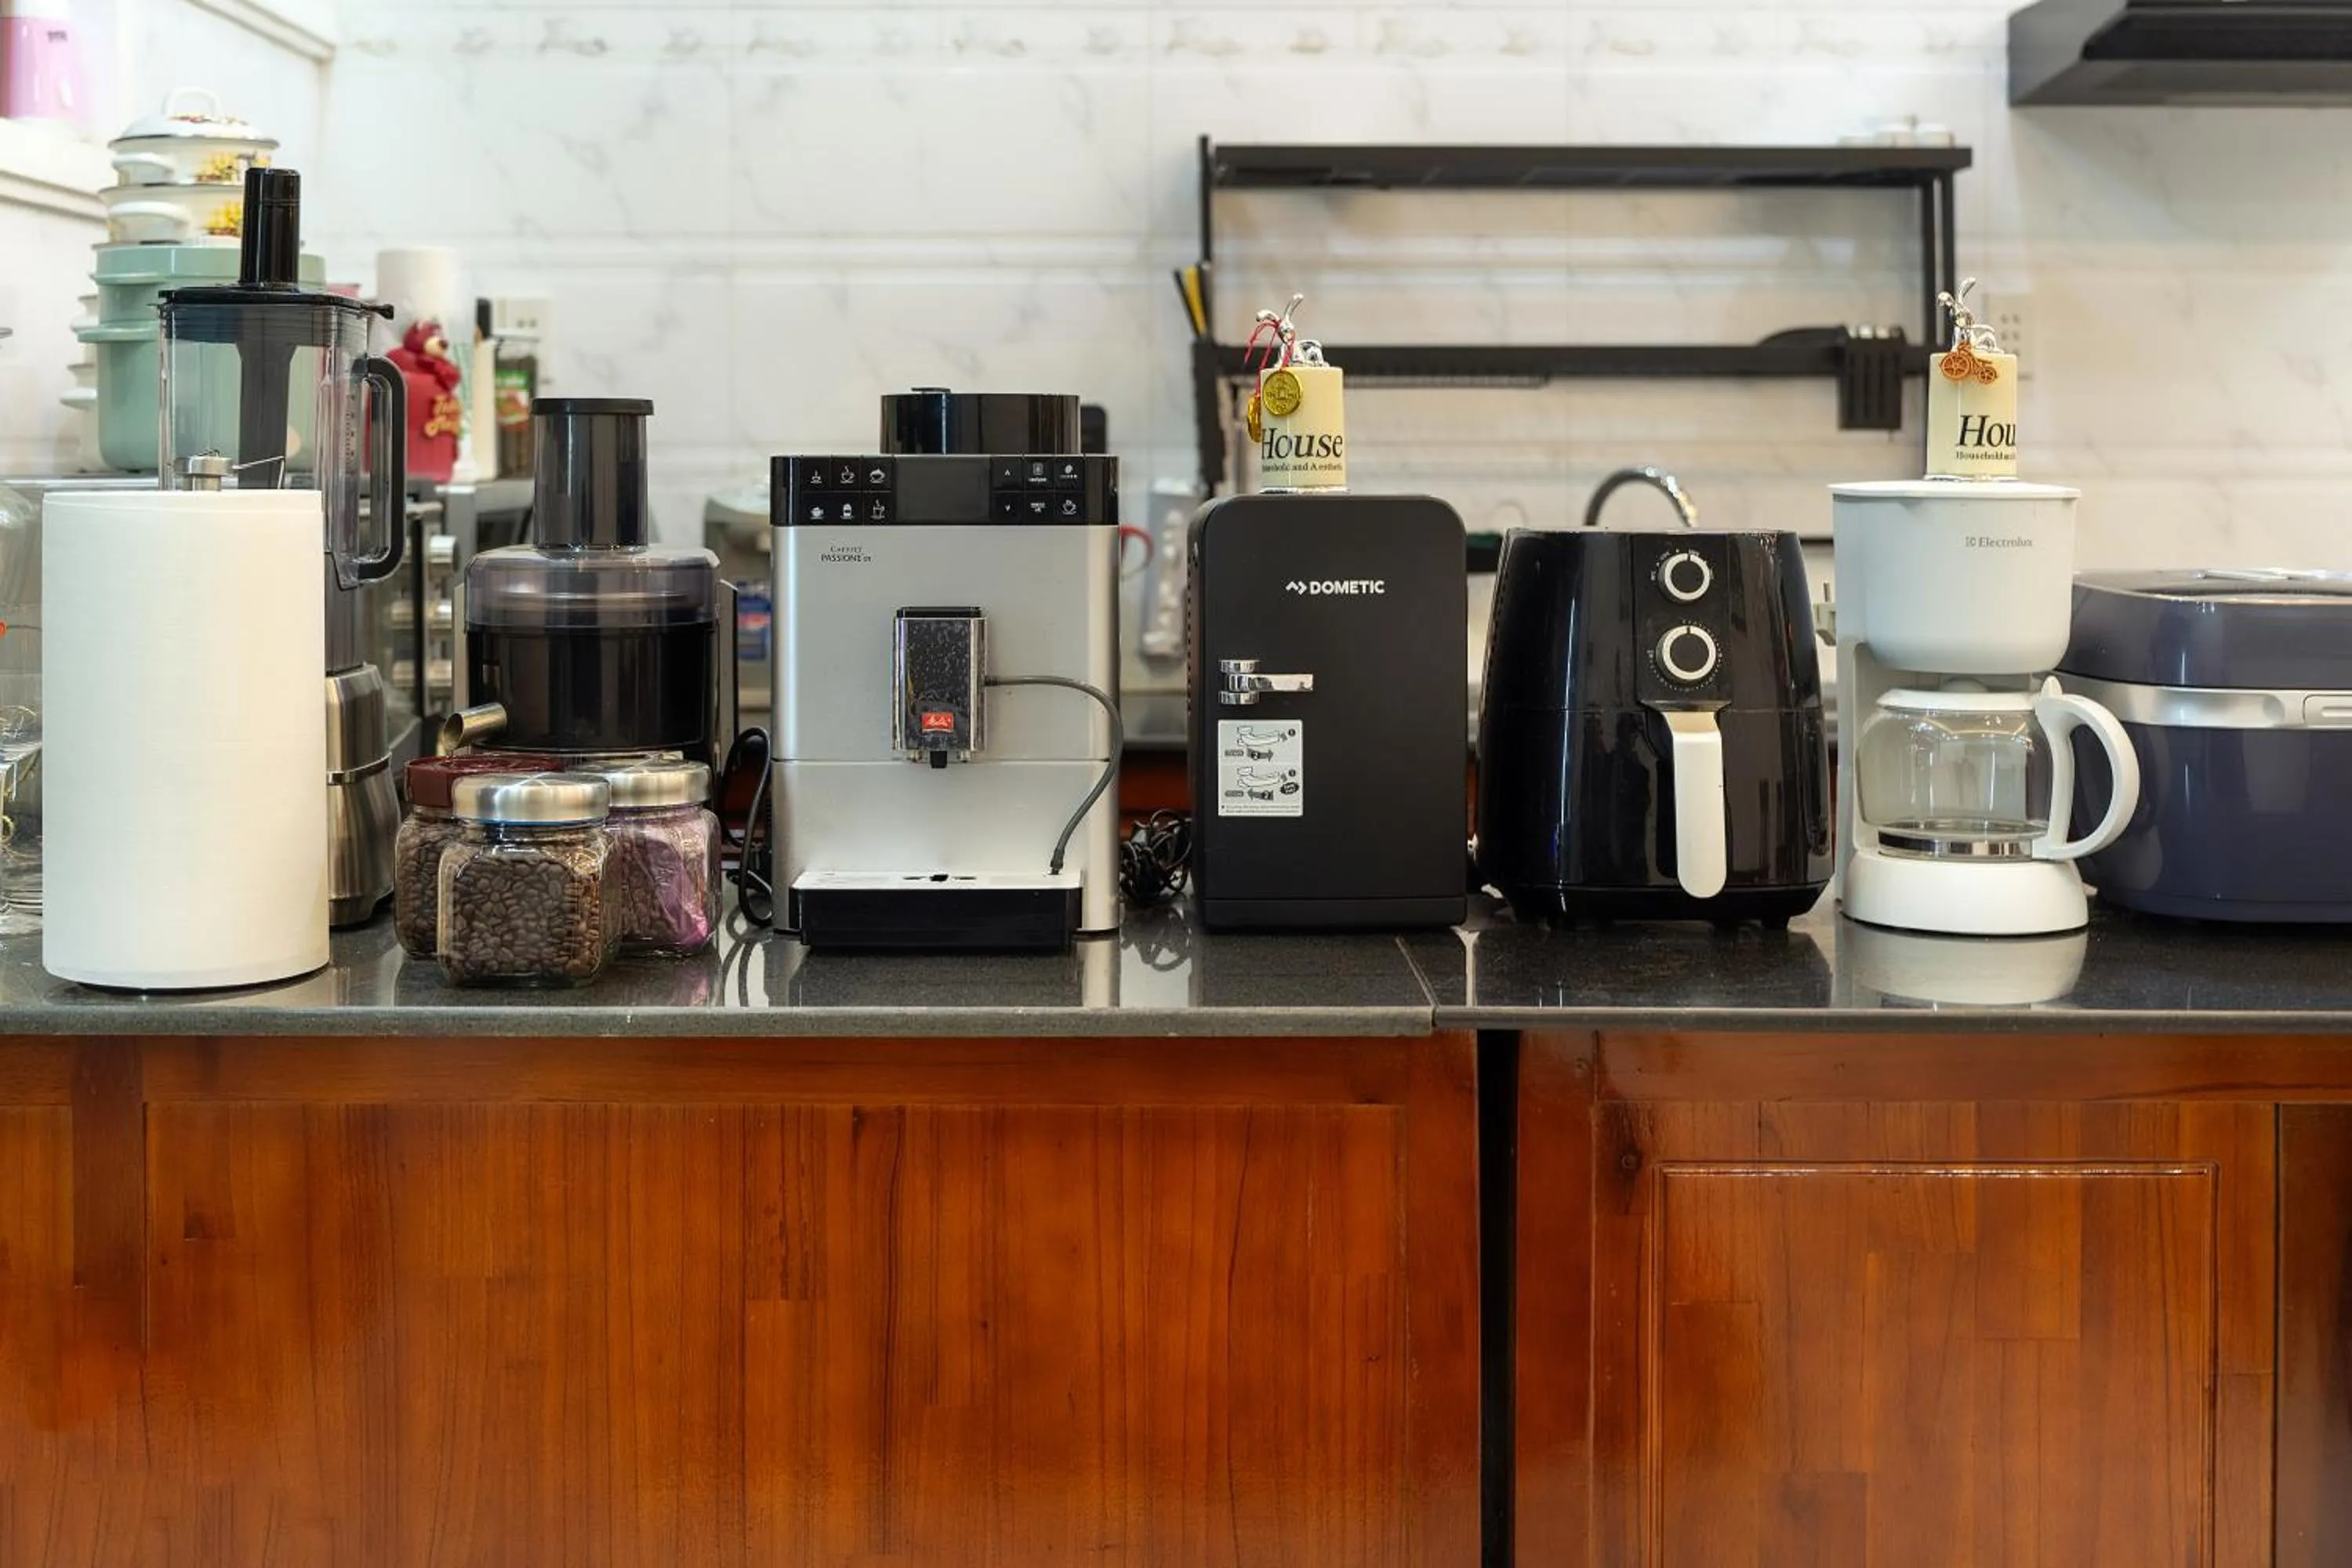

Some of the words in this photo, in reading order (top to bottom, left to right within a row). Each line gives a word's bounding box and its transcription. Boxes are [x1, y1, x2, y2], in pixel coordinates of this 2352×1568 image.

[1261, 427, 1342, 459] House
[1292, 463, 1308, 471] and
[1978, 536, 2033, 548] Electrolux
[1309, 580, 1385, 594] DOMETIC
